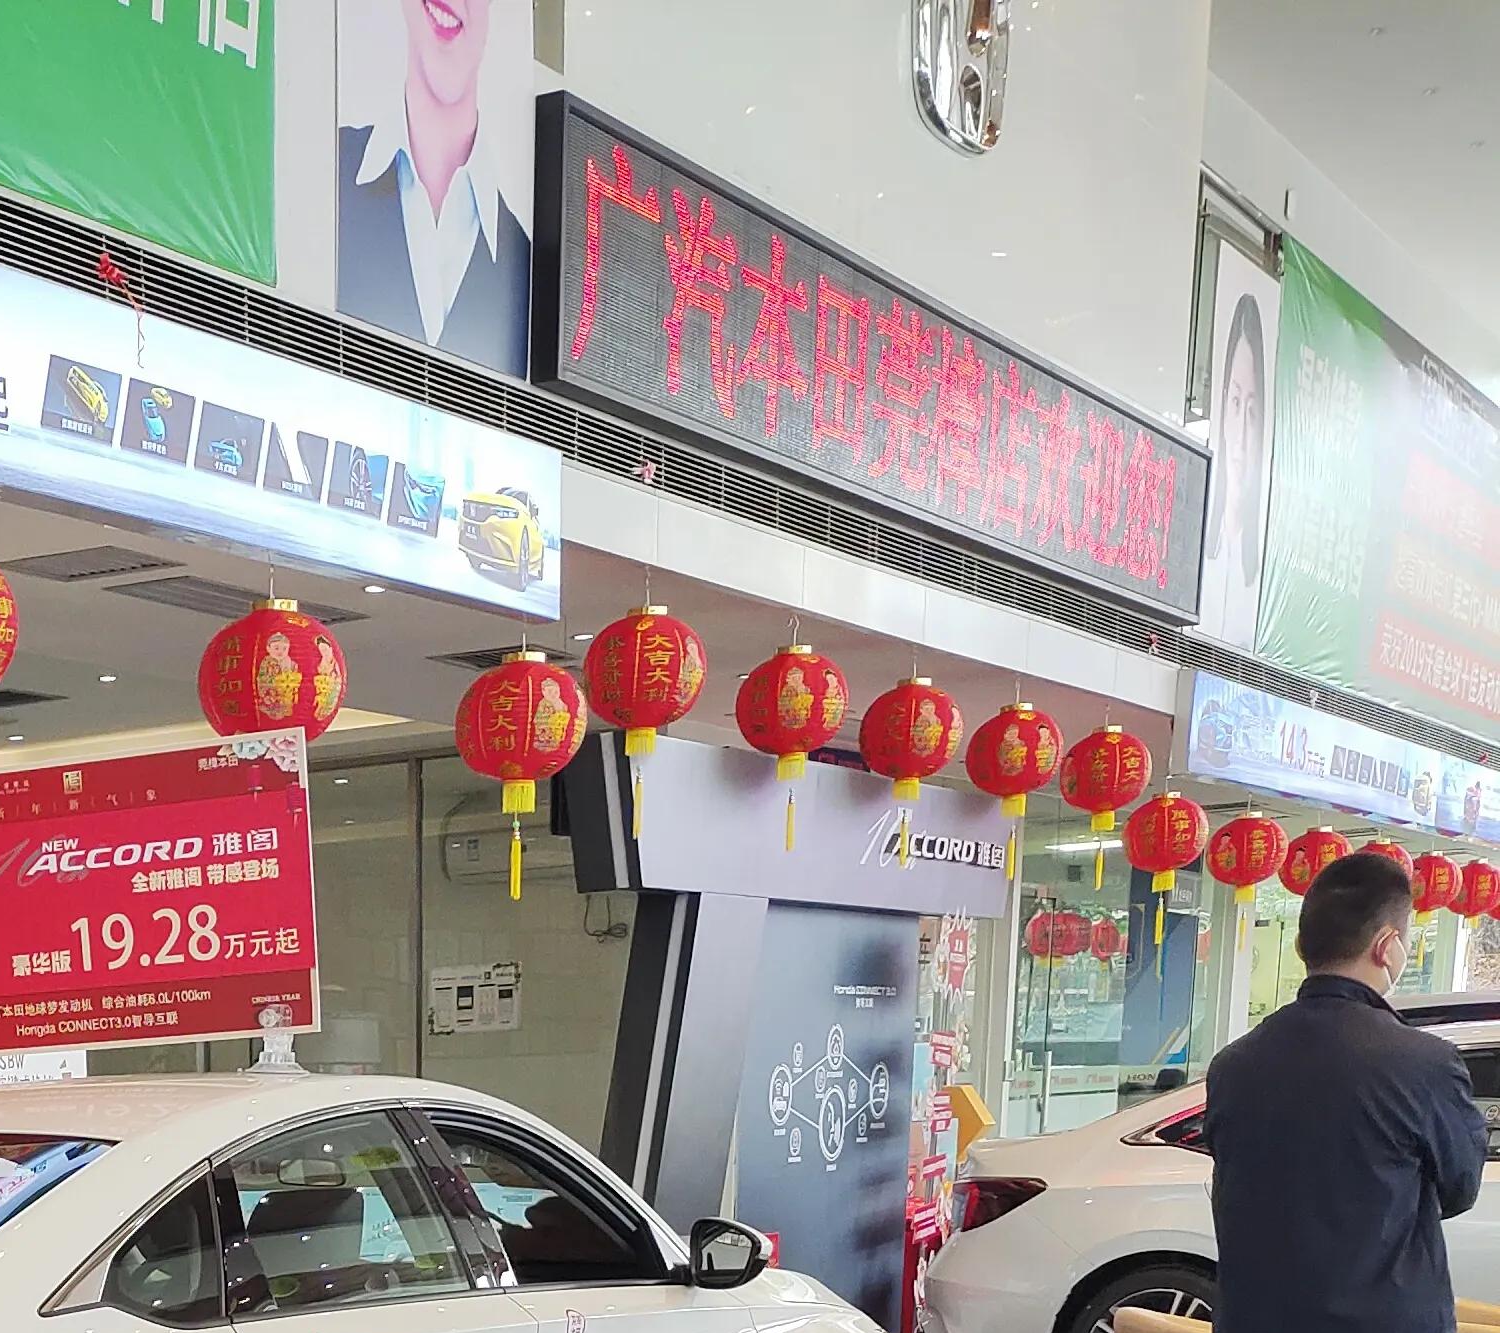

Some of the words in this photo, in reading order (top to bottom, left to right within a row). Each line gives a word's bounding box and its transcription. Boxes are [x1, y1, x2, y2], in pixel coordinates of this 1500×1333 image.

[643, 634, 676, 702] 大吉大利
[487, 680, 522, 752] 大吉大利
[27, 837, 202, 875] ACCORD
[212, 828, 277, 856] 雅阁
[42, 838, 78, 852] NEW
[131, 866, 202, 893] 全新雅阁
[207, 858, 279, 885] 带感登场
[12, 950, 71, 977] 豪华版
[71, 904, 221, 972] 19.28
[224, 928, 300, 960] 万元起
[0, 1055, 24, 1070] SBW
